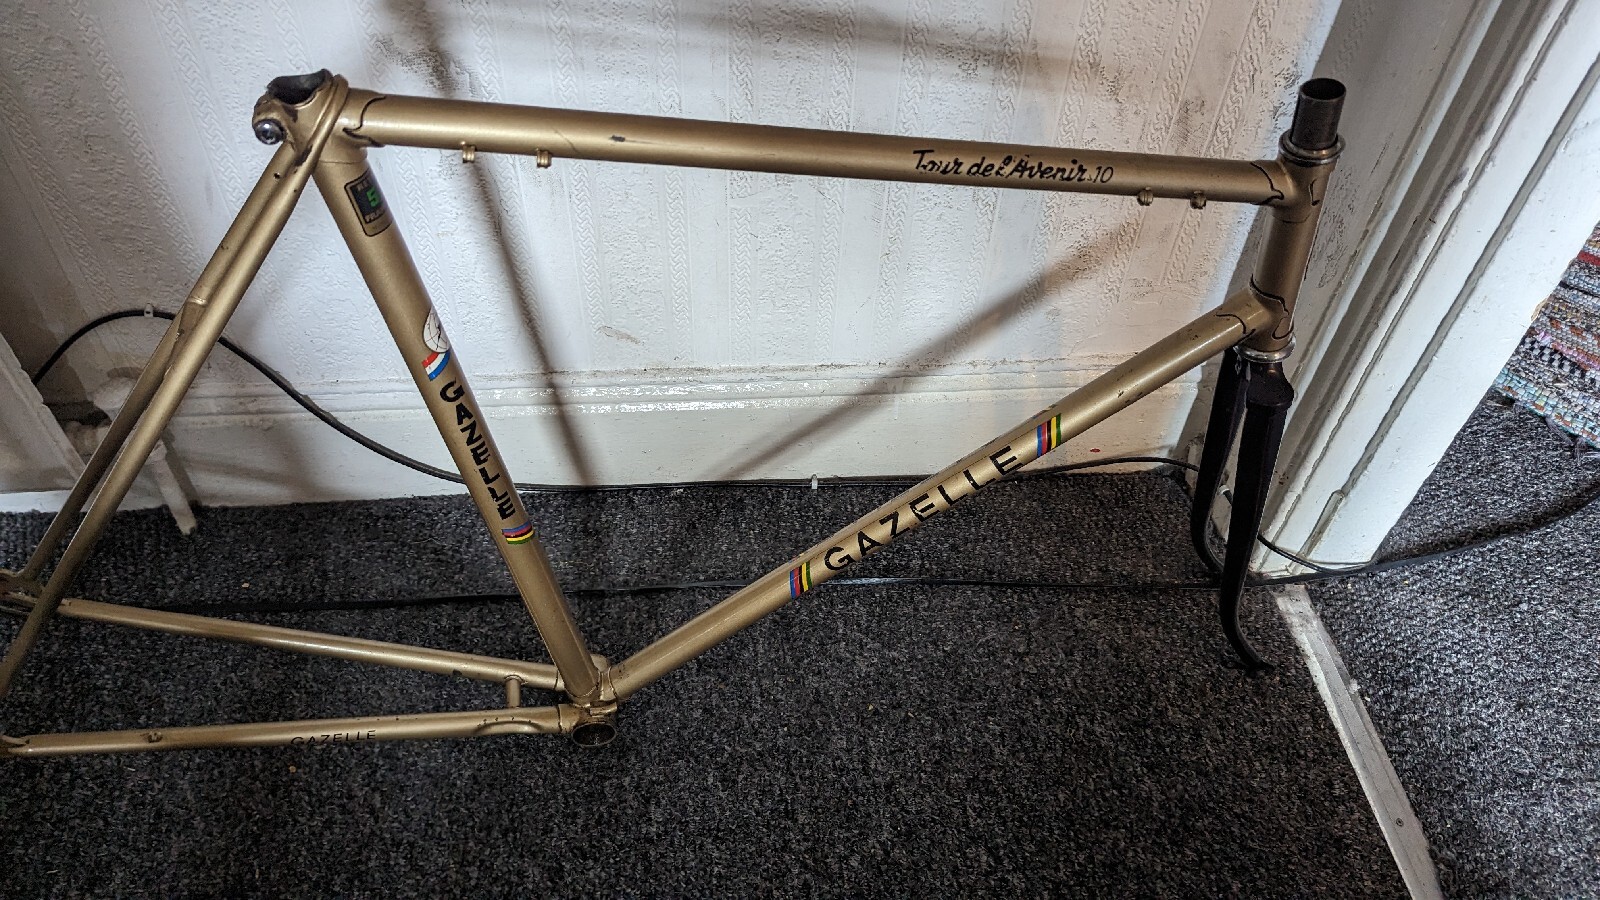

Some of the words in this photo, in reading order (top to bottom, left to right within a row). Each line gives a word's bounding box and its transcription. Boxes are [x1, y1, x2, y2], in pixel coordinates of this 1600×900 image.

[913, 150, 964, 175] Tour
[967, 157, 995, 177] de
[439, 378, 516, 520] GAZELLE
[824, 445, 1024, 571] GAZELLE
[290, 729, 376, 746] GAZELLE
